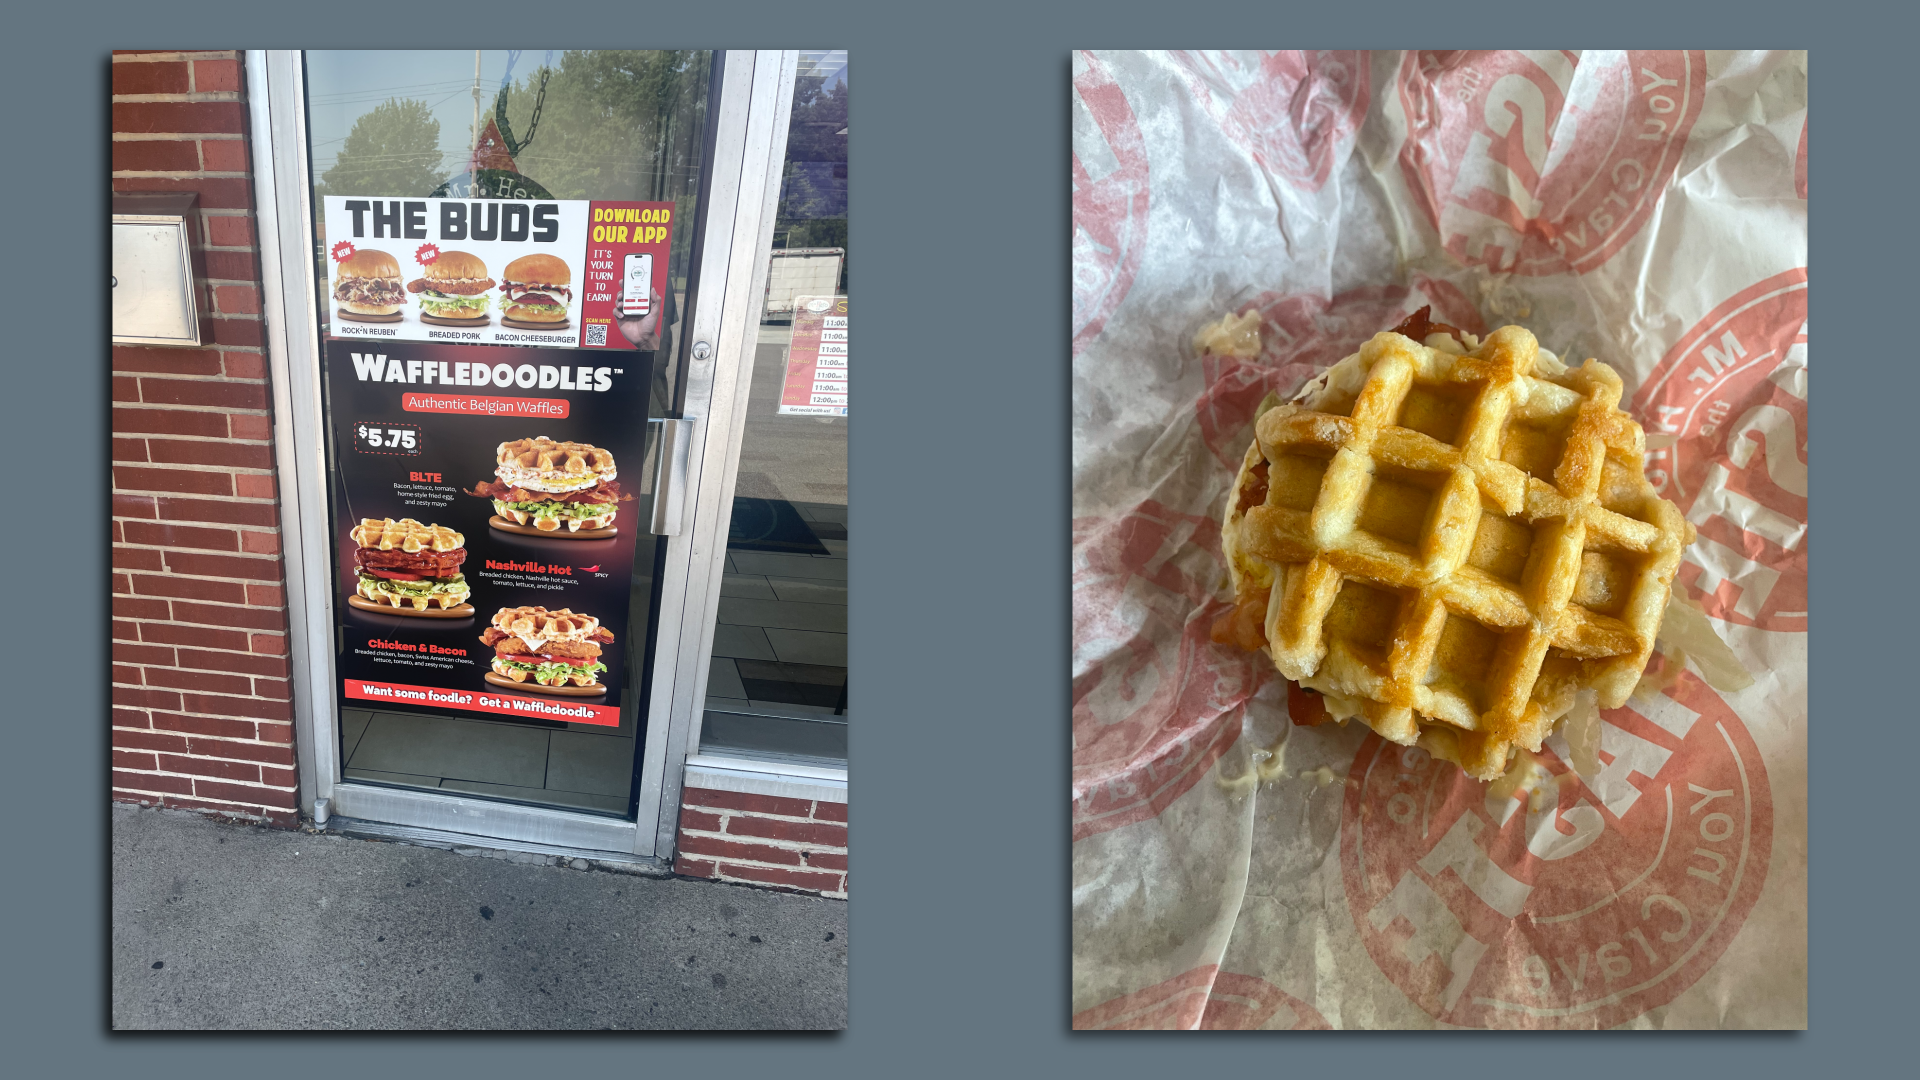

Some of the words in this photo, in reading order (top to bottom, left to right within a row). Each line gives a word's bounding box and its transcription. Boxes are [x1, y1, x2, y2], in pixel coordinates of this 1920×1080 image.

[496, 176, 536, 200] He
[345, 200, 427, 239] THE
[440, 202, 559, 242] BUDS
[594, 208, 670, 223] DOWNLOAD
[593, 225, 628, 243] OUR
[633, 226, 667, 243] APP
[337, 247, 351, 258] NEW
[421, 249, 436, 260] NEW
[594, 250, 612, 258] IT'S
[591, 261, 614, 270] YOUR
[589, 272, 613, 280] TURN
[595, 283, 606, 291] TO
[587, 293, 612, 302] EARN!
[429, 331, 460, 339] BREADED
[462, 332, 480, 340] PORK
[495, 333, 520, 342] BACON
[521, 334, 576, 344] CHEESEBURGER
[408, 396, 467, 409] Authentic
[470, 399, 514, 414] Belgian
[516, 401, 563, 414] Waffles
[359, 425, 416, 448] $5.75
[410, 472, 442, 483] BLTE
[393, 482, 412, 490] Bacon,
[434, 485, 457, 493] tomato,
[486, 560, 546, 573] Nashville
[548, 564, 572, 575] Hot
[368, 639, 417, 652] Chicken
[419, 644, 427, 653] &
[429, 644, 467, 656] Bacon
[430, 655, 454, 663] American
[362, 685, 393, 696] Want
[394, 688, 426, 700] some
[428, 690, 472, 705] foodle?
[479, 696, 502, 708] Get
[503, 700, 511, 709] a
